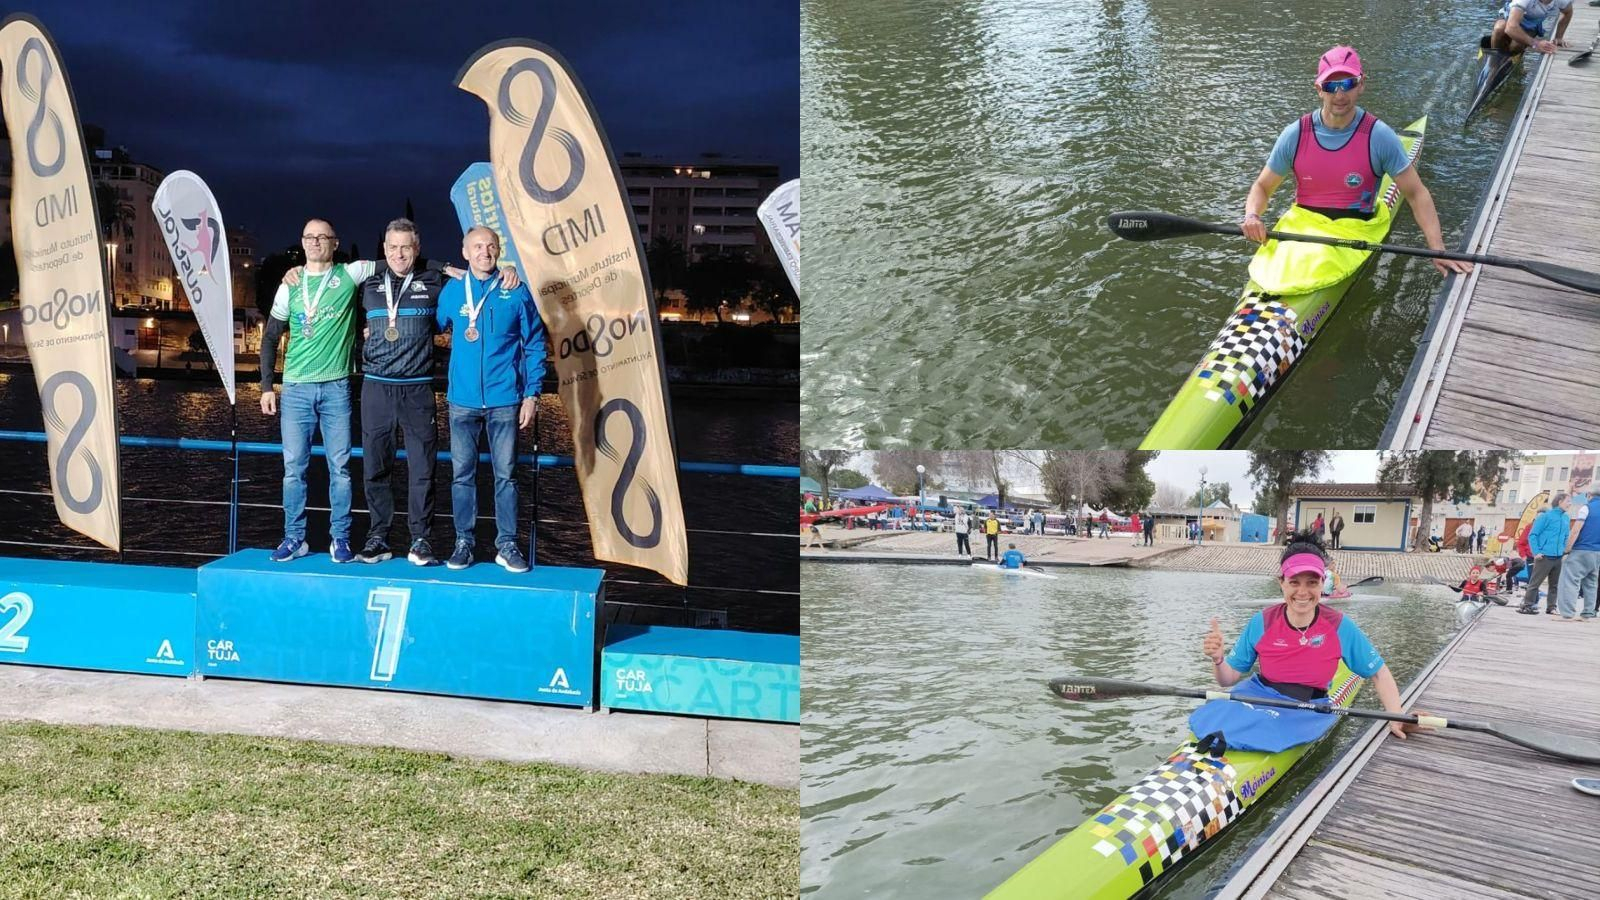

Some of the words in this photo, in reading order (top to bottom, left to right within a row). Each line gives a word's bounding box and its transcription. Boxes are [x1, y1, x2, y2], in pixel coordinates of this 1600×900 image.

[0, 591, 34, 653] 2
[367, 586, 412, 681] 1
[208, 640, 233, 651] CAR
[208, 650, 240, 662] TUJA
[616, 669, 646, 681] CAR
[616, 679, 653, 693] TUJA
